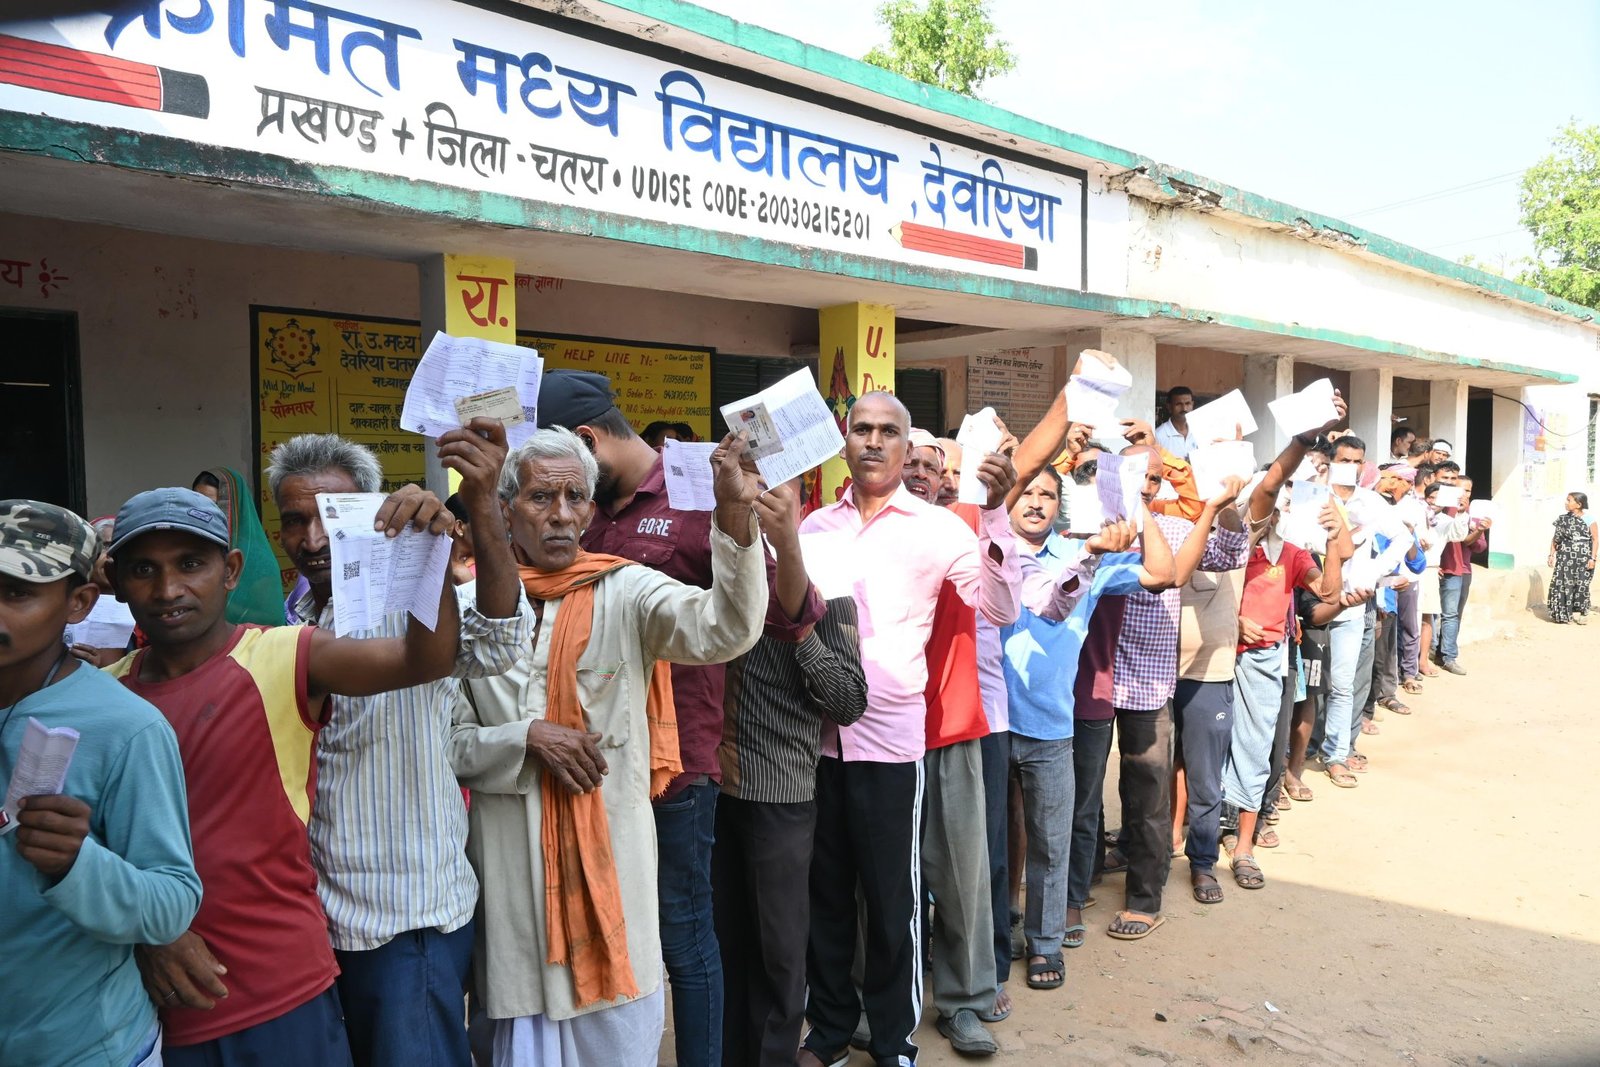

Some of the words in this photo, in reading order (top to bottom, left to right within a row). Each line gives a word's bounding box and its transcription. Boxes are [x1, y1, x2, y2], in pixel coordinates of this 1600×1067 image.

[254, 85, 384, 153] प्रखण्ड
[632, 165, 691, 208] UDISE
[454, 38, 635, 136] मध्य
[920, 143, 1062, 242] देवरिया
[456, 275, 509, 327] रा.
[384, 334, 417, 353] मध्य
[340, 350, 385, 372] देवरिया
[564, 349, 595, 361] HELP
[605, 353, 630, 365] LINE
[263, 379, 278, 392] Mid
[281, 379, 296, 393] Day
[298, 381, 316, 393] Meal
[637, 517, 673, 537] CORE
